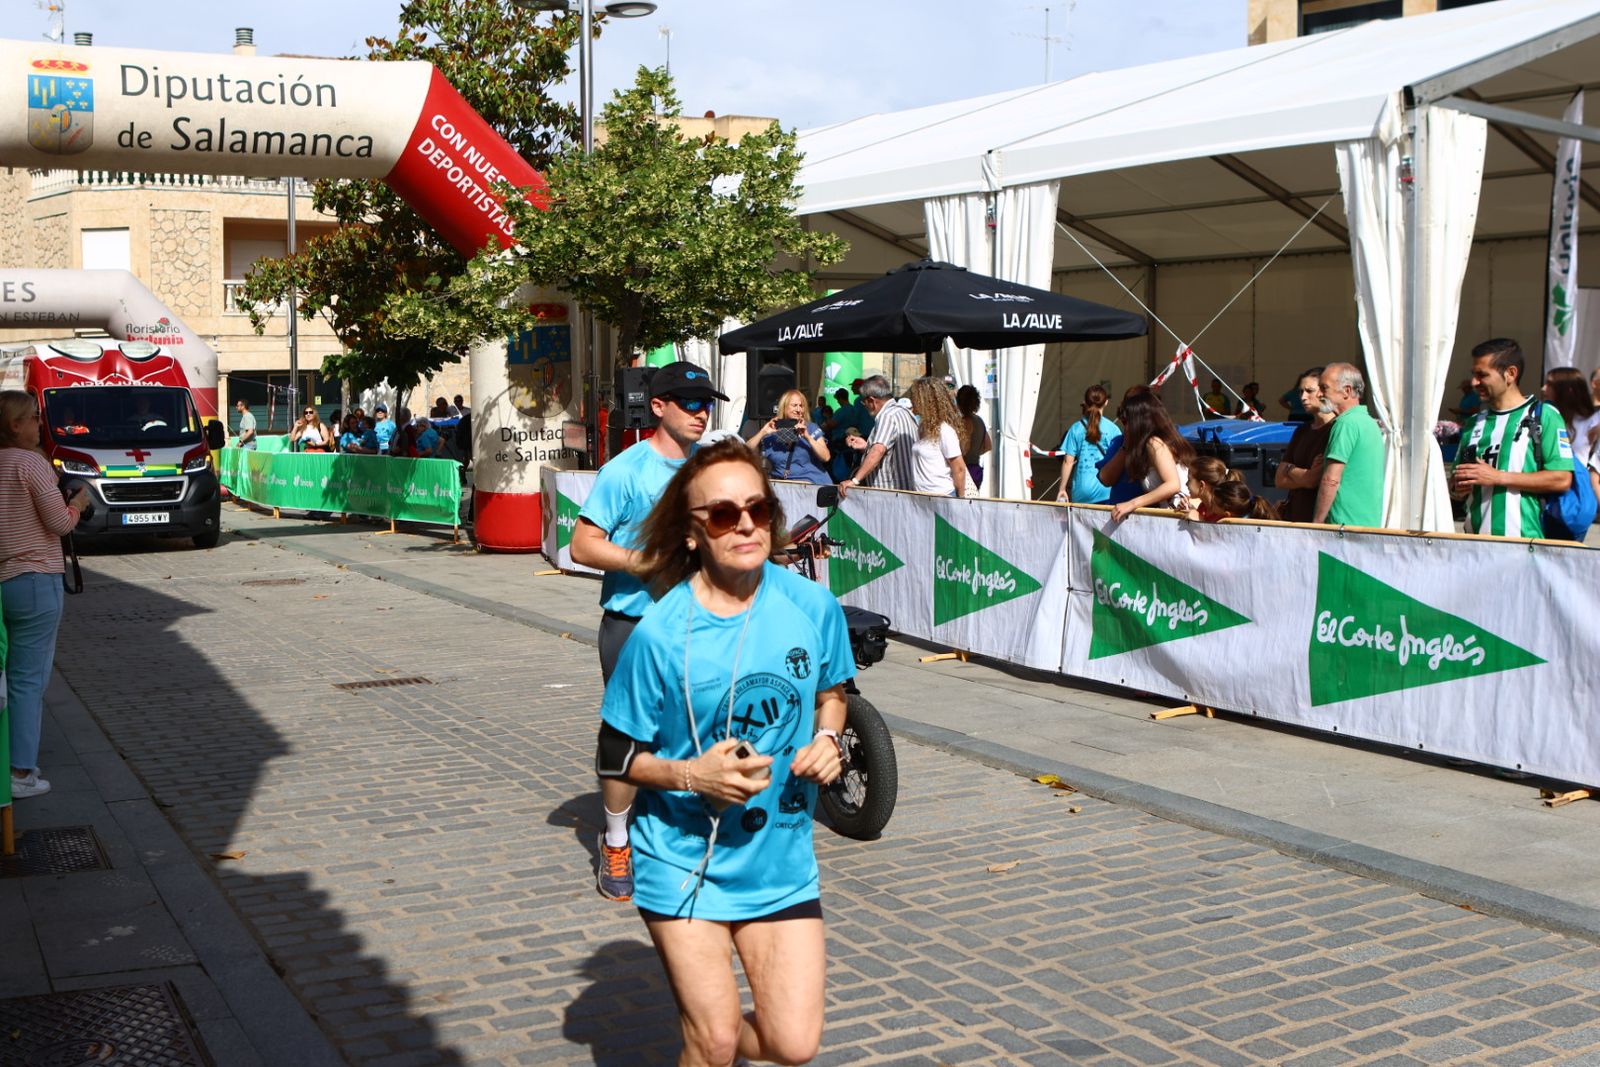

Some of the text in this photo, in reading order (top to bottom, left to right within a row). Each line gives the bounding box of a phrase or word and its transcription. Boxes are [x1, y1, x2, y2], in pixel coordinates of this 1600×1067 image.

[120, 64, 337, 108] Diputación
[117, 117, 374, 159] de Salamanca
[431, 114, 467, 151] CON
[417, 138, 516, 236] DEPORTISTAS
[14, 311, 80, 322] ESTEBAN
[778, 322, 824, 342] LA SALVE
[1003, 313, 1063, 330] LA SALVE
[501, 427, 563, 445] Diputac
[496, 451, 508, 462] de
[129, 514, 150, 523] 4955
[936, 555, 1016, 597] El Corte Inglés
[1094, 578, 1208, 630] El Corte Inglés
[1316, 610, 1486, 671] El Corte Inglés
